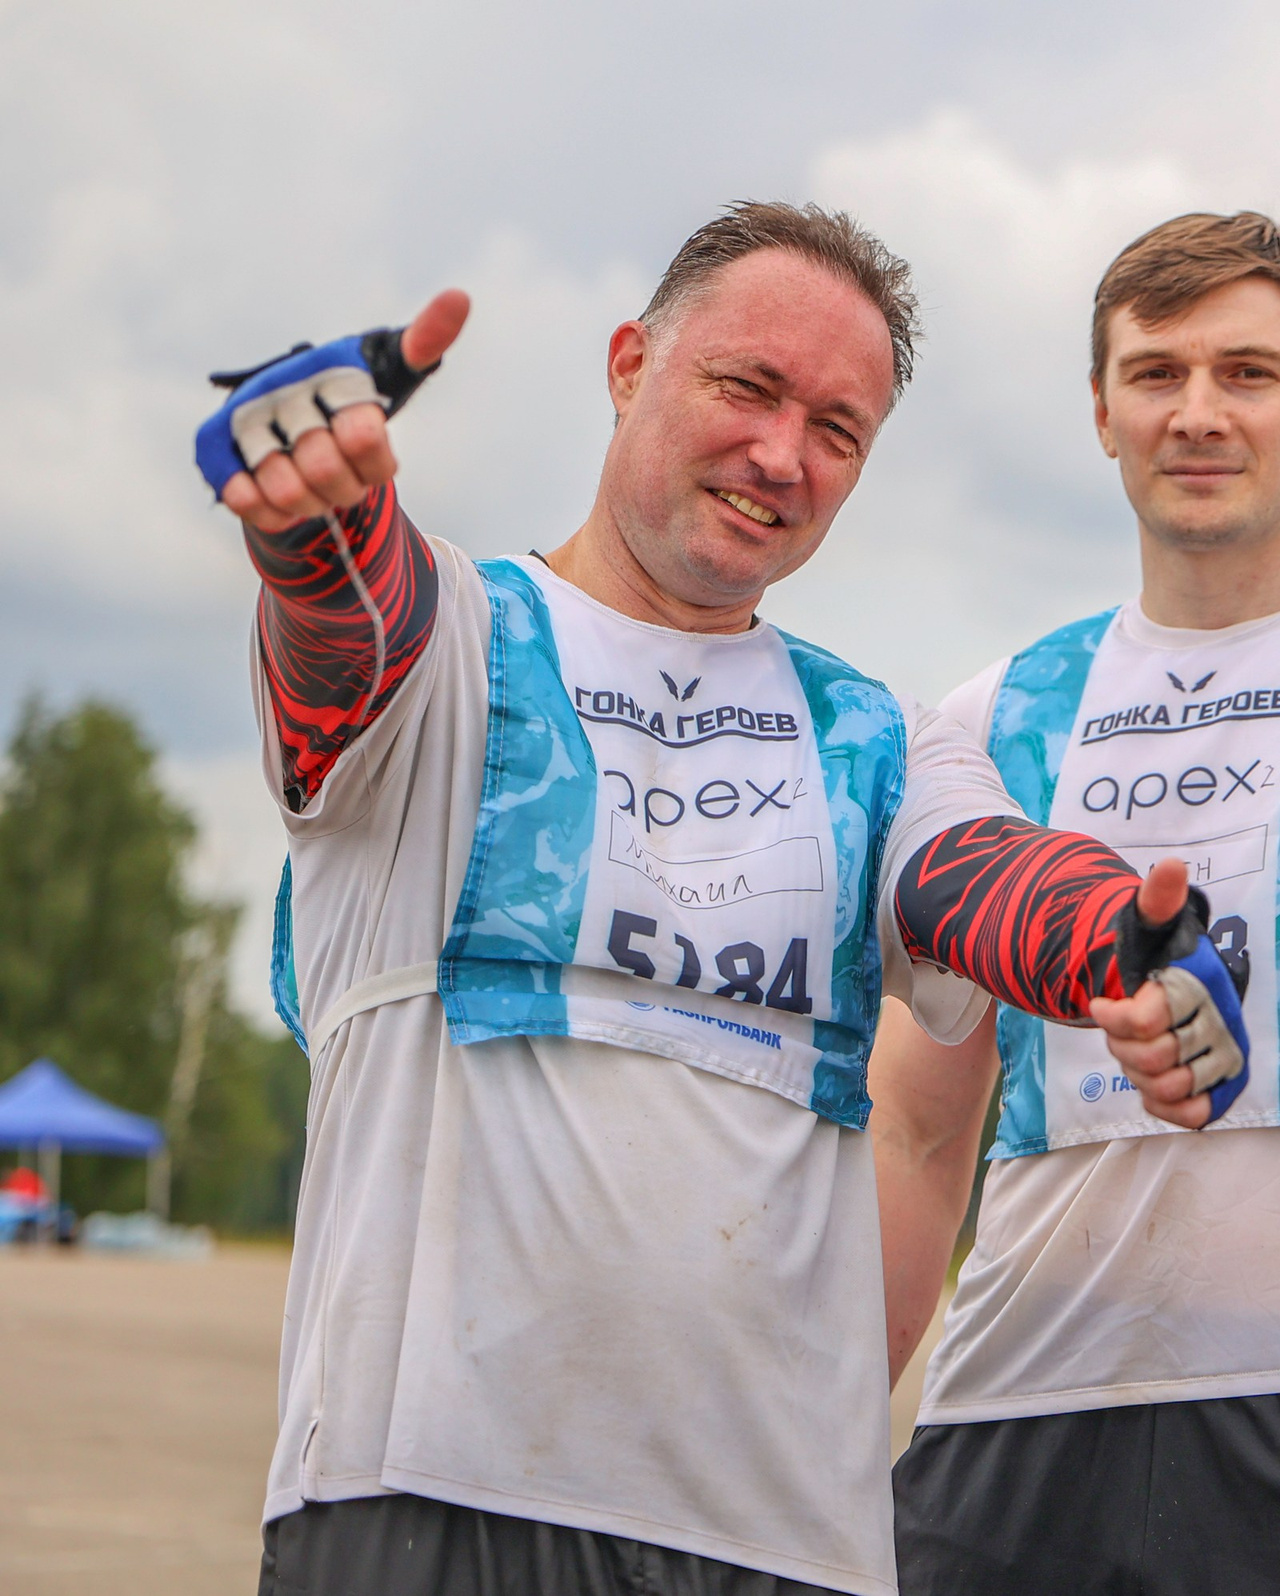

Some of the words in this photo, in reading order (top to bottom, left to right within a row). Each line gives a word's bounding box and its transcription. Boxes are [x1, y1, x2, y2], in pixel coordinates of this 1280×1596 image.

[575, 686, 667, 738] ГОНКА
[676, 705, 798, 738] ГЕРОЕВ
[1083, 704, 1171, 738] ГОНКА
[662, 1005, 782, 1050] ОМБАНК
